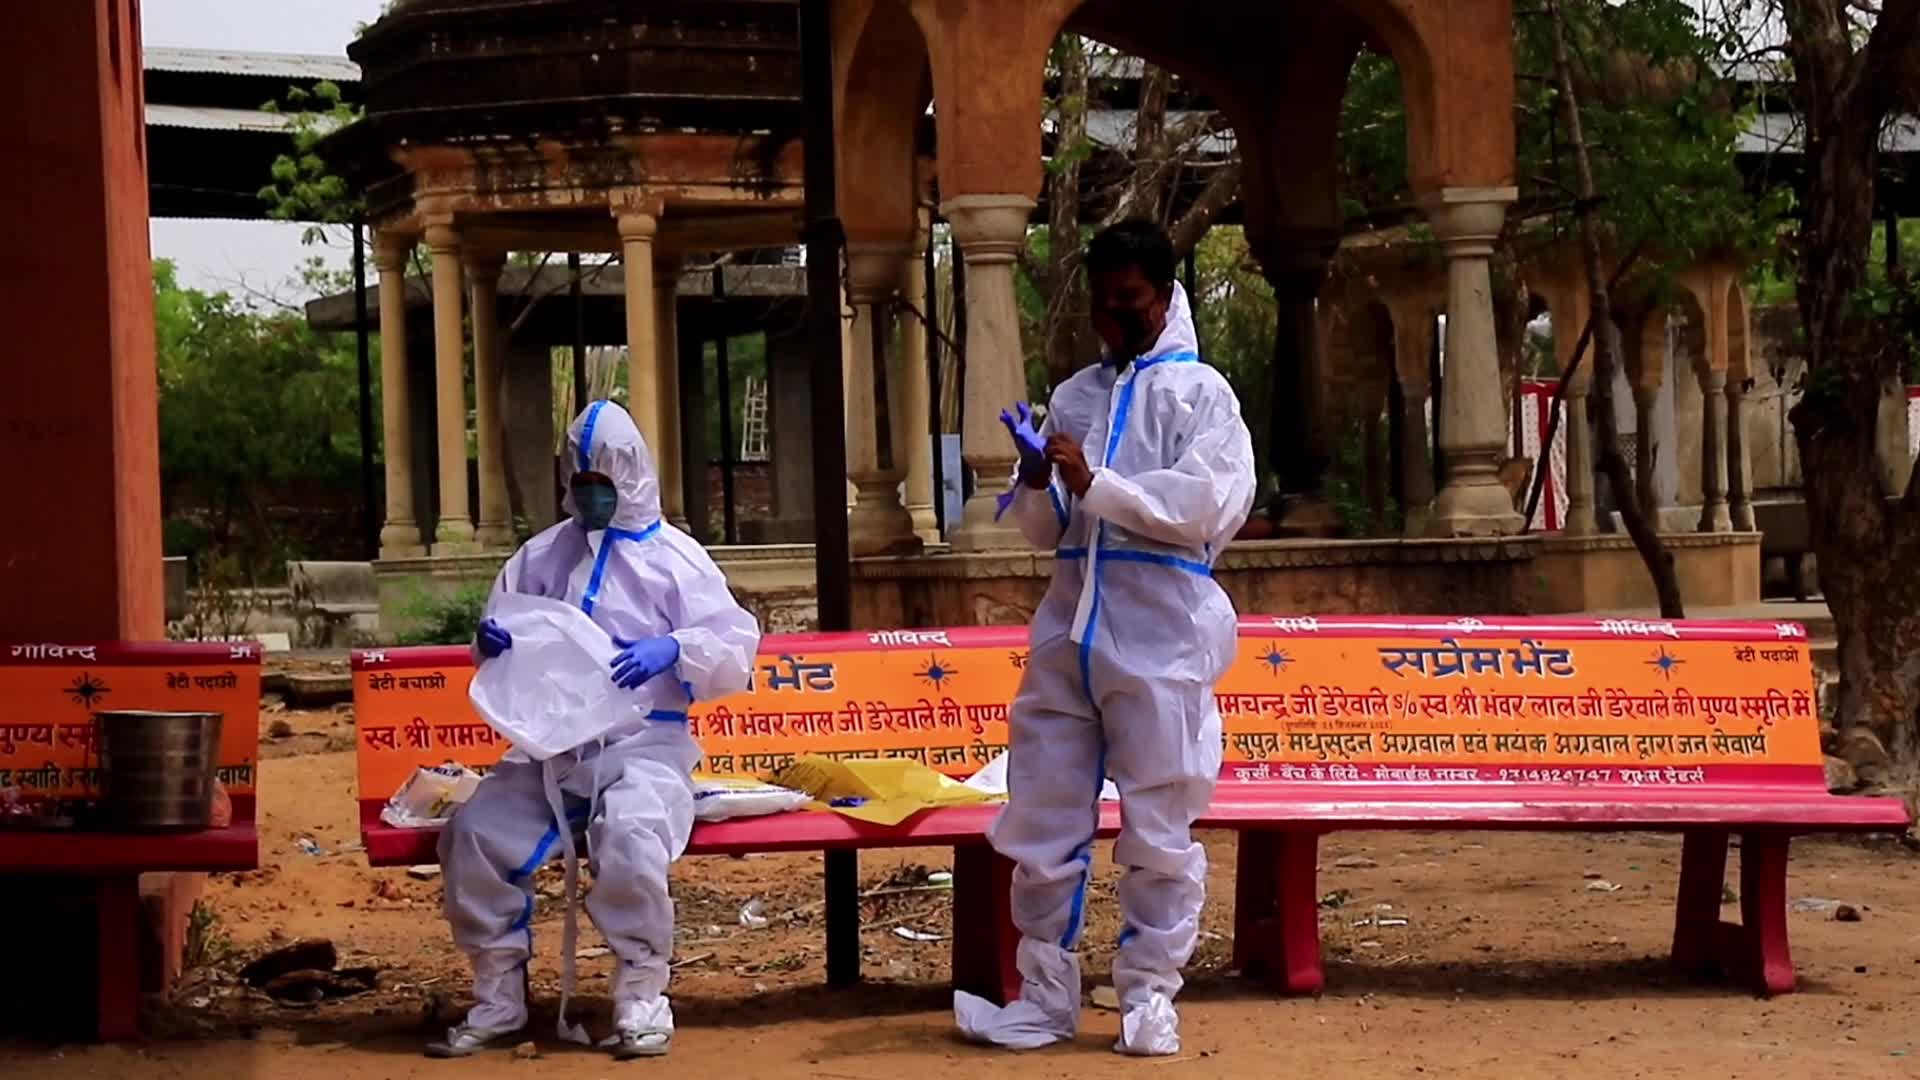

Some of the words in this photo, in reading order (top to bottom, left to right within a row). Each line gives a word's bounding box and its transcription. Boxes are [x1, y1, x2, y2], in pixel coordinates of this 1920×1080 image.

[1377, 635, 1502, 677] सप्रेम
[1507, 637, 1575, 677] भेंट
[1733, 645, 1756, 663] बेटी
[369, 673, 395, 691] बेटी
[399, 672, 446, 689] बचाओ
[761, 655, 834, 692] भेंट
[1290, 685, 1318, 716] जी
[1454, 687, 1478, 715] श्री
[1525, 694, 1576, 717] लाल
[1577, 687, 1602, 716] जी
[1671, 687, 1696, 716] की
[1697, 696, 1739, 725] पुण्य
[1740, 688, 1792, 726] स्मृति
[1791, 689, 1811, 716] में
[404, 717, 430, 748] श्री
[706, 706, 735, 737] श्री
[786, 711, 833, 736] लाल
[838, 700, 863, 732] जी
[939, 697, 962, 728] की
[965, 703, 1008, 734] पुण्य
[1380, 732, 1456, 754] अग्रवाल
[1553, 732, 1630, 755] अग्रवाल
[1676, 733, 1708, 754] जन
[1711, 726, 1767, 754] सेवार्थ
[930, 746, 967, 766] जन
[1309, 764, 1325, 779] के
